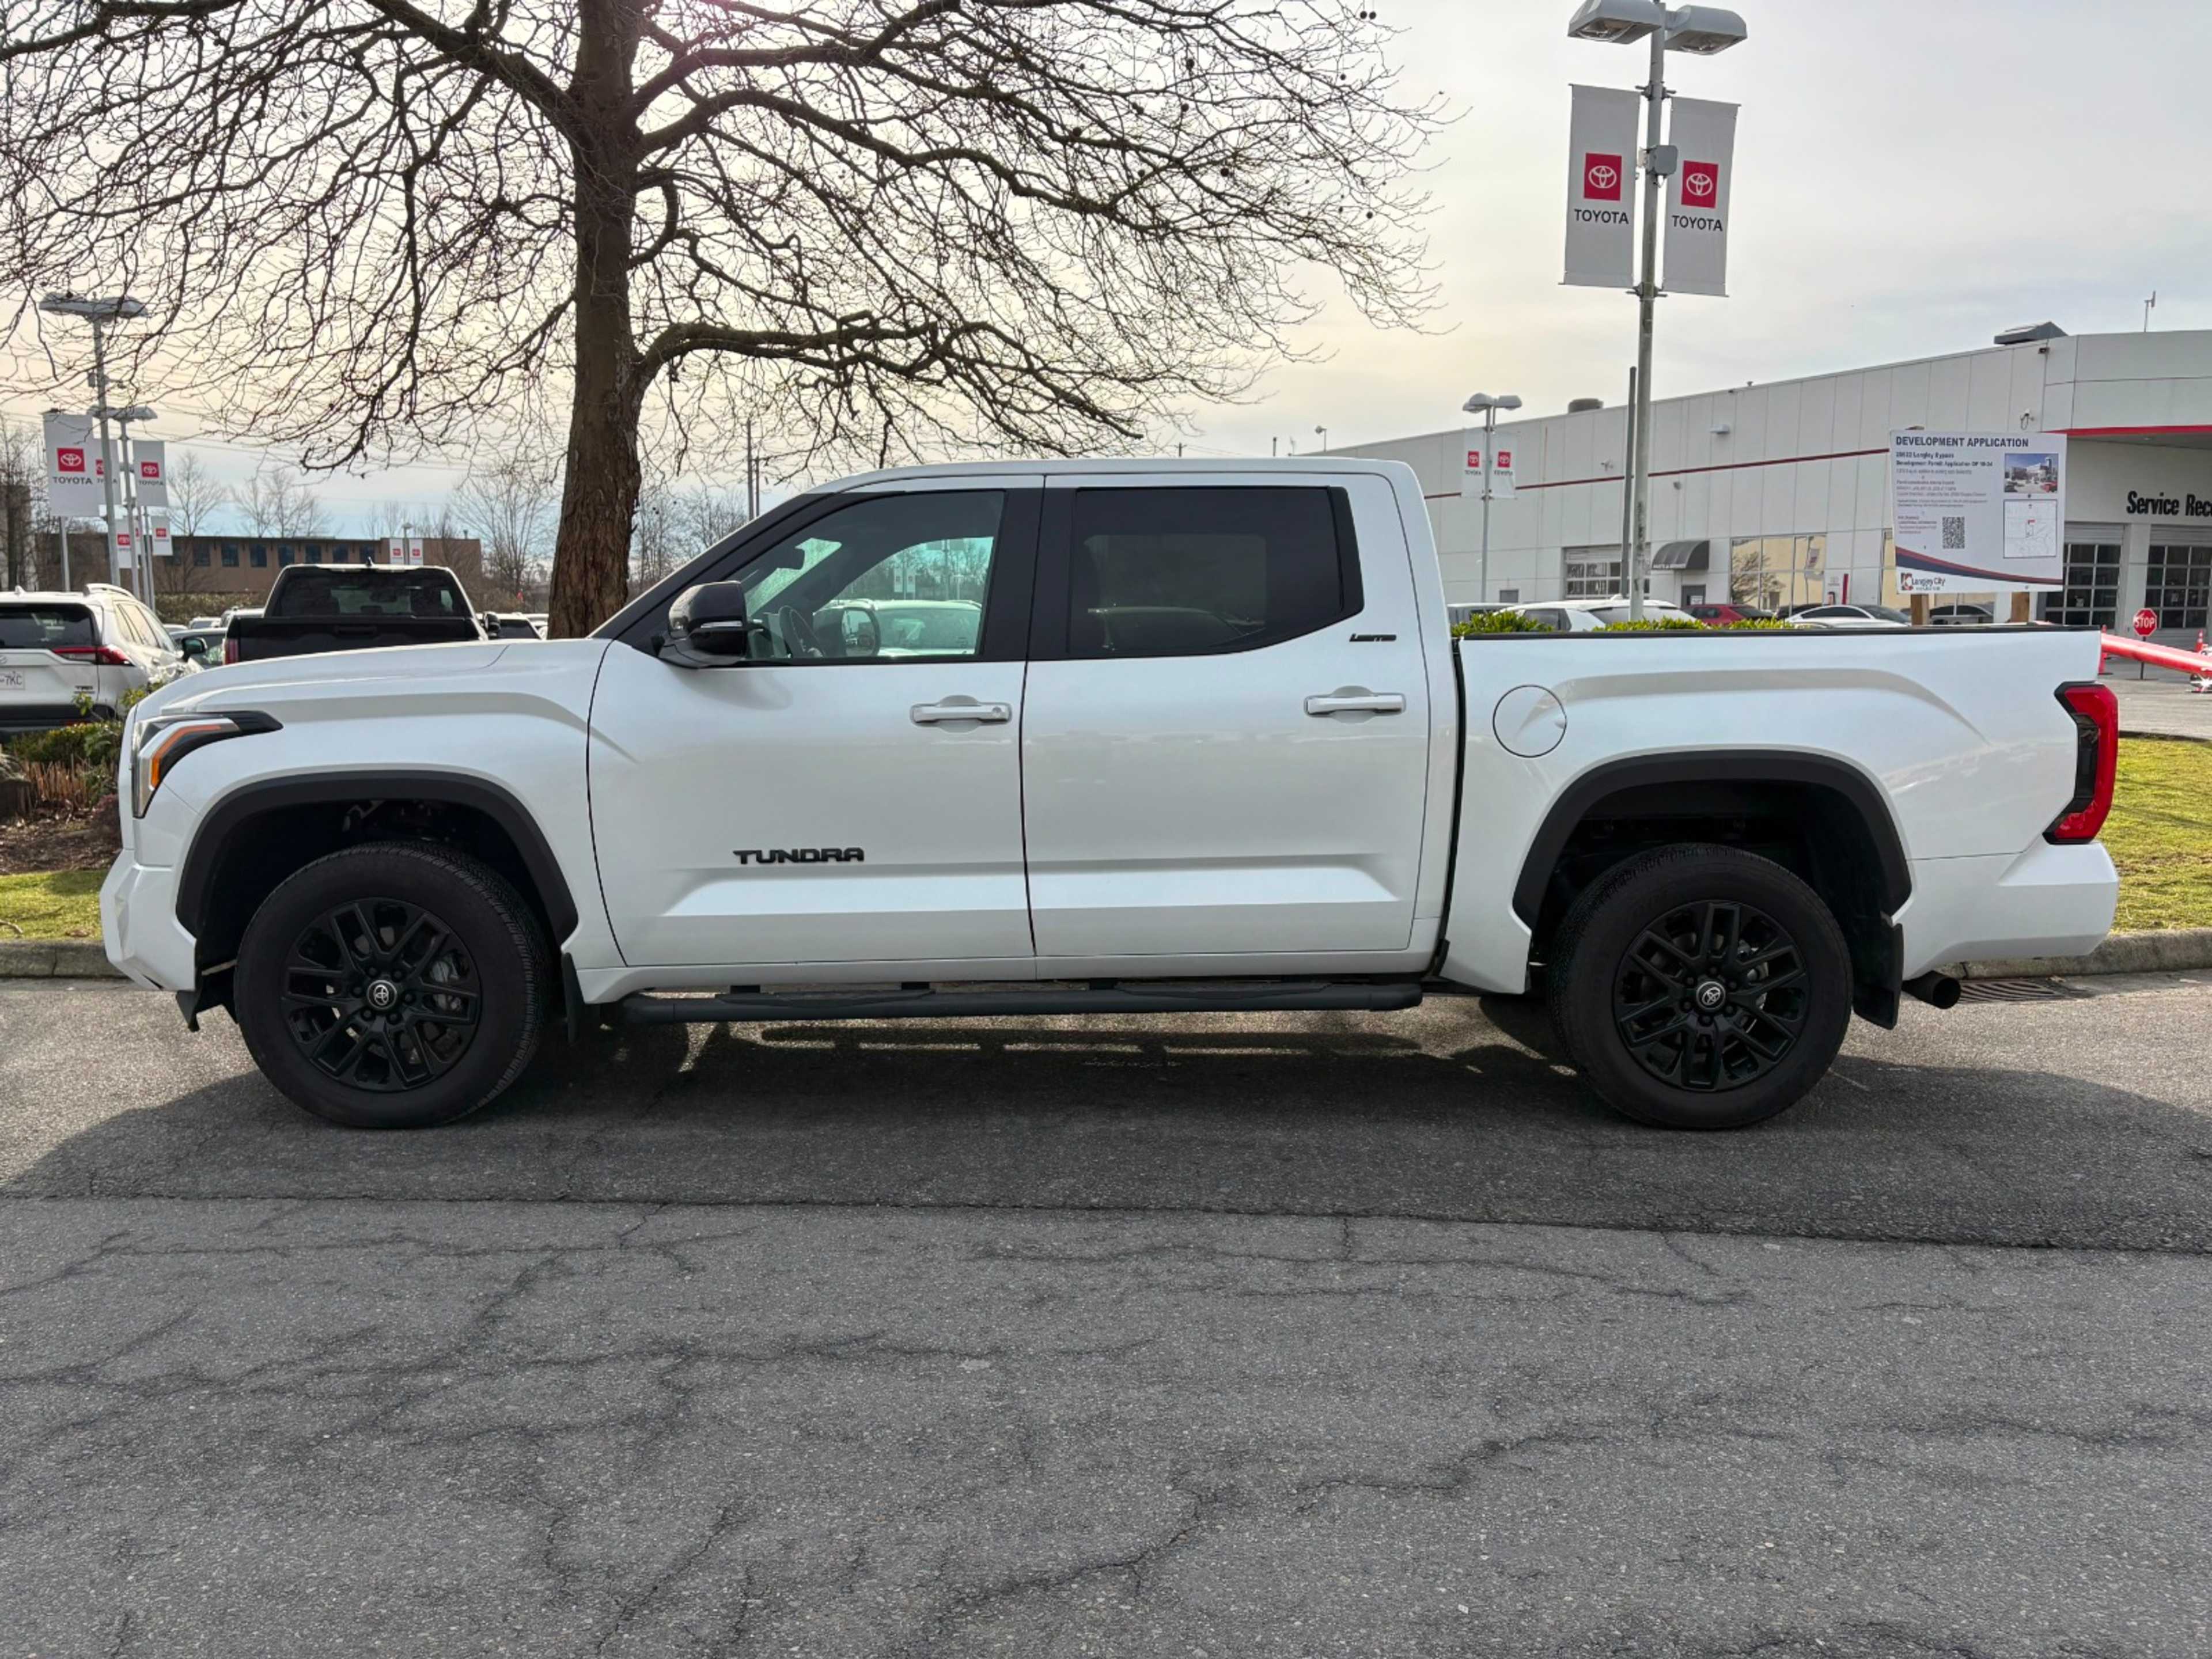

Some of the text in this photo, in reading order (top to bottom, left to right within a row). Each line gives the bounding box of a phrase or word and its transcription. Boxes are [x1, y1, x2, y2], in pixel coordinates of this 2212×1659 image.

[1574, 209, 1629, 225] TOYOTA
[1672, 215, 1723, 232] TOYOTA
[1896, 436, 2029, 448] DEVELOPMENT APPLICATION
[52, 476, 93, 485] TOYOTA
[2126, 490, 2212, 517] Service Rec
[2134, 617, 2155, 628] STOP
[732, 847, 865, 865] TUNDRA
